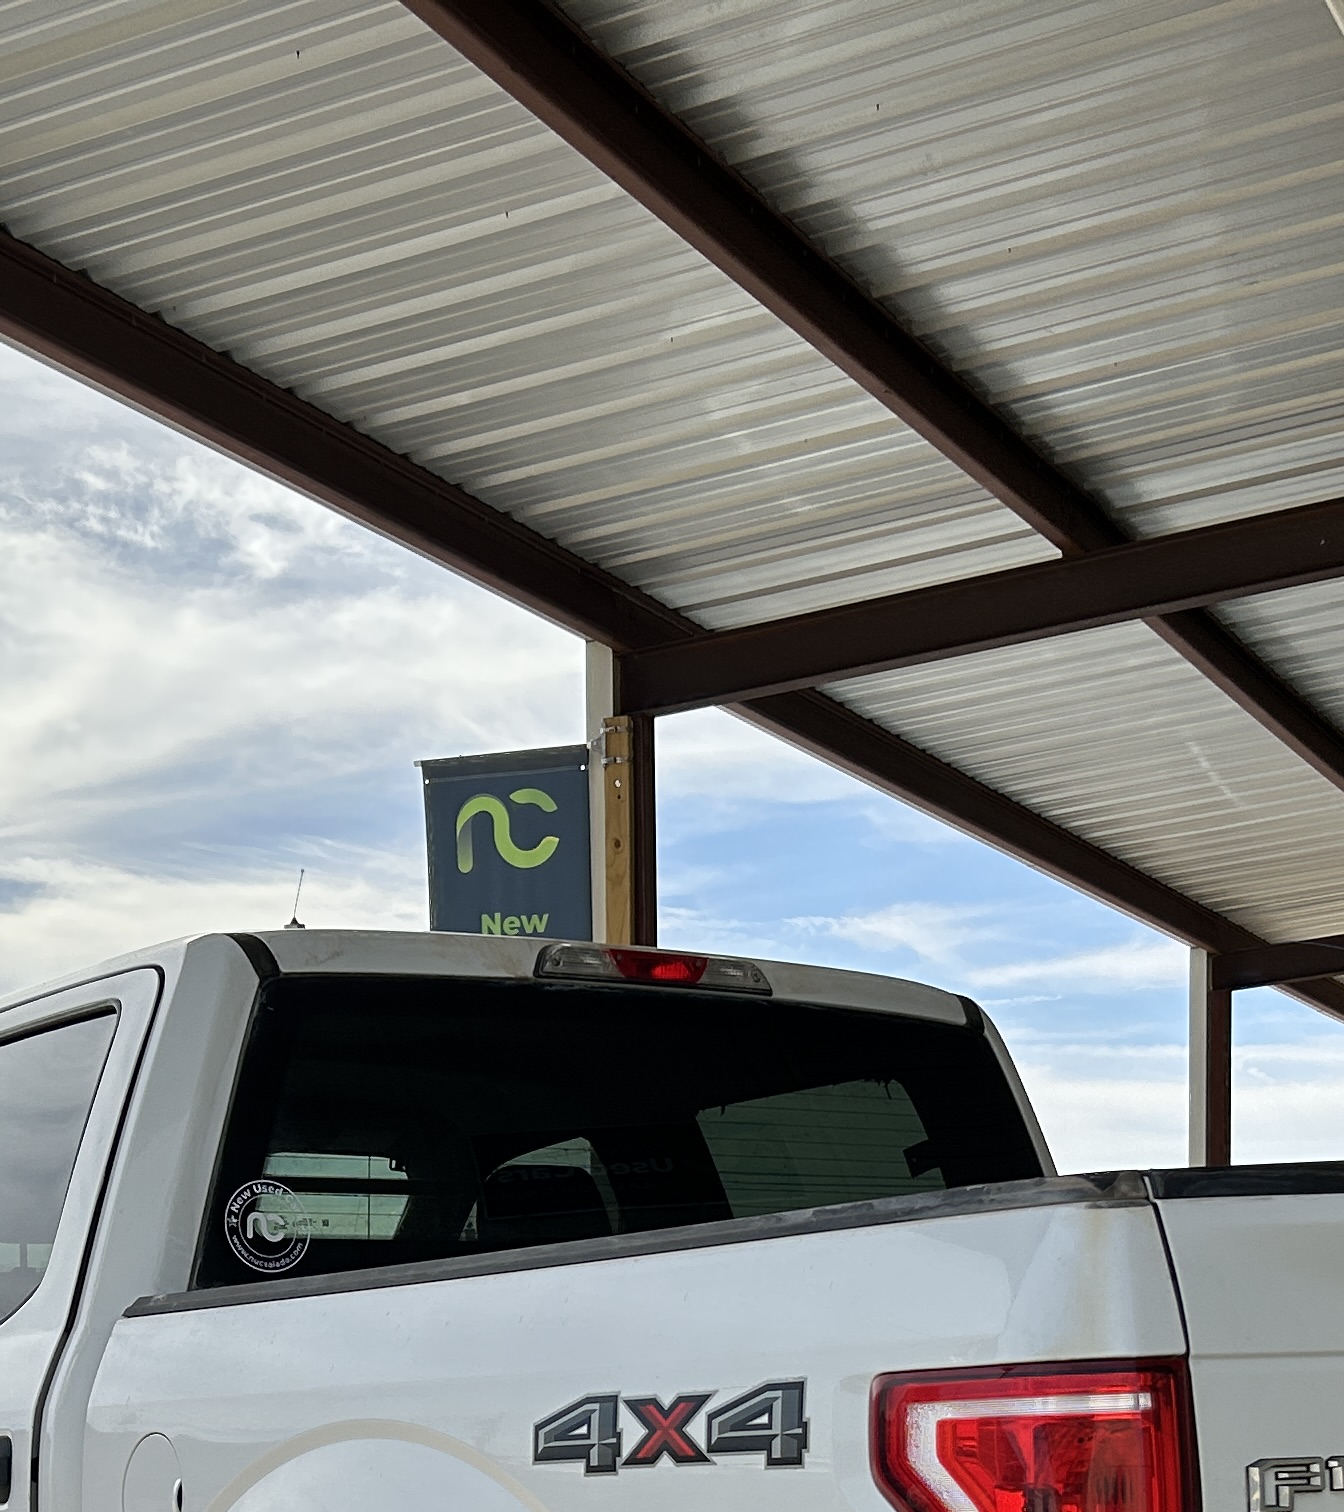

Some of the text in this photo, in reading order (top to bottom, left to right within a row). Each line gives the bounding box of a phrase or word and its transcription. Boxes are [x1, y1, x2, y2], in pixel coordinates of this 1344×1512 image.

[480, 912, 549, 936] New
[230, 1183, 284, 1213] New Used
